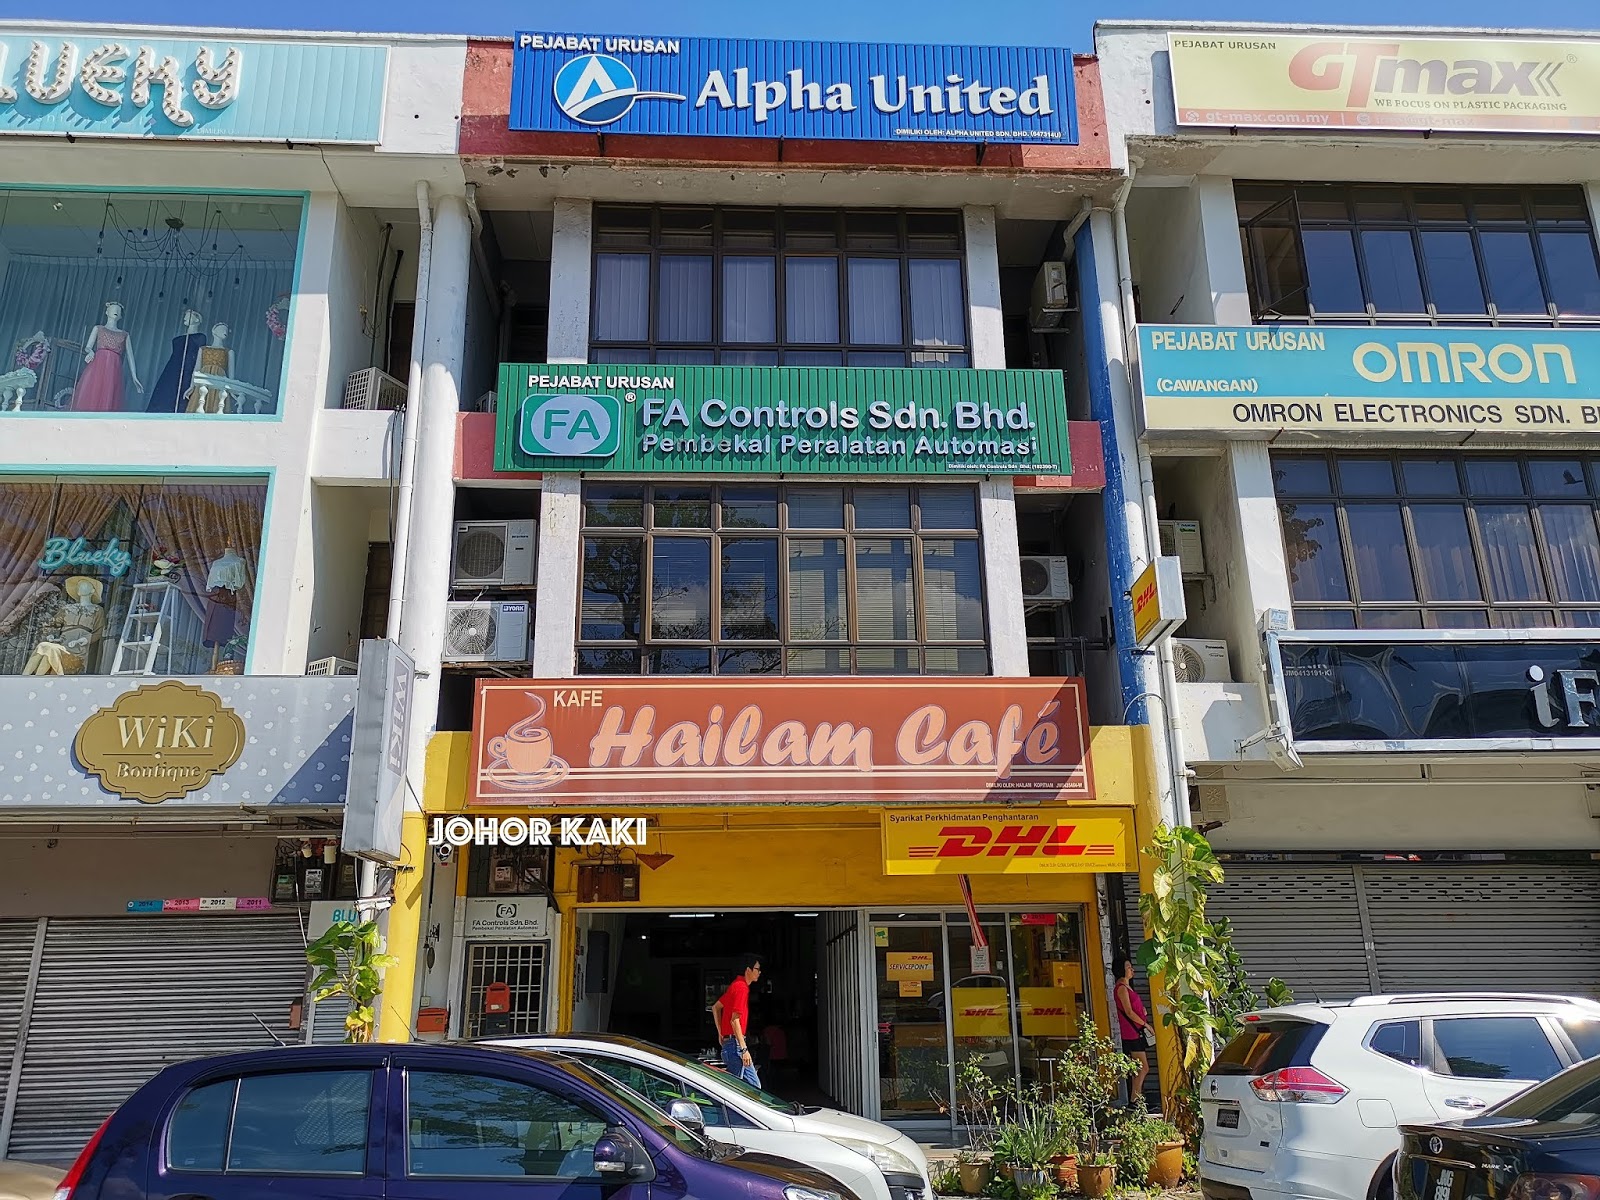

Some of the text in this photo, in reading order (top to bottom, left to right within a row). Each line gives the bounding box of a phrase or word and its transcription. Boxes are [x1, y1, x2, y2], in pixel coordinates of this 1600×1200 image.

[519, 34, 681, 55] PEJABAT URUSAN
[1174, 40, 1276, 50] PEJABAT URUSAN
[695, 67, 1054, 123] Alpha United
[1375, 98, 1567, 111] WE FOCUS ON PLASTIC PACKAGING
[1205, 109, 1330, 125] gt-max.com.my
[1151, 331, 1326, 351] PEJABAT URUSAN
[1352, 341, 1577, 384] OMRON
[528, 375, 674, 389] PEJABAT URUSAN
[1156, 377, 1259, 393] (CAWANGAN)
[643, 398, 1036, 430] FA Controls Sdn. Bhd.
[1232, 403, 1323, 423] OMRON
[1334, 403, 1503, 423] ELECTRONICS
[1515, 405, 1571, 424] SDN.
[543, 408, 601, 441] FA
[642, 433, 1038, 455] Pembekal Peralatan Automasi
[1136, 582, 1155, 613] DHL
[553, 690, 603, 707] KAFE
[116, 714, 215, 749] WiKi
[588, 700, 1061, 780] Hailam Café
[116, 761, 201, 782] Boutique
[889, 814, 923, 823] Syarikat
[982, 813, 1039, 822] Penghantaran
[936, 825, 1088, 857] DHL
[500, 906, 513, 915] FA
[889, 963, 929, 971] SERVICEPOINT
[965, 1008, 997, 1017] DHL
[1032, 1007, 1065, 1016] DHL
[1502, 1163, 1514, 1173] X
